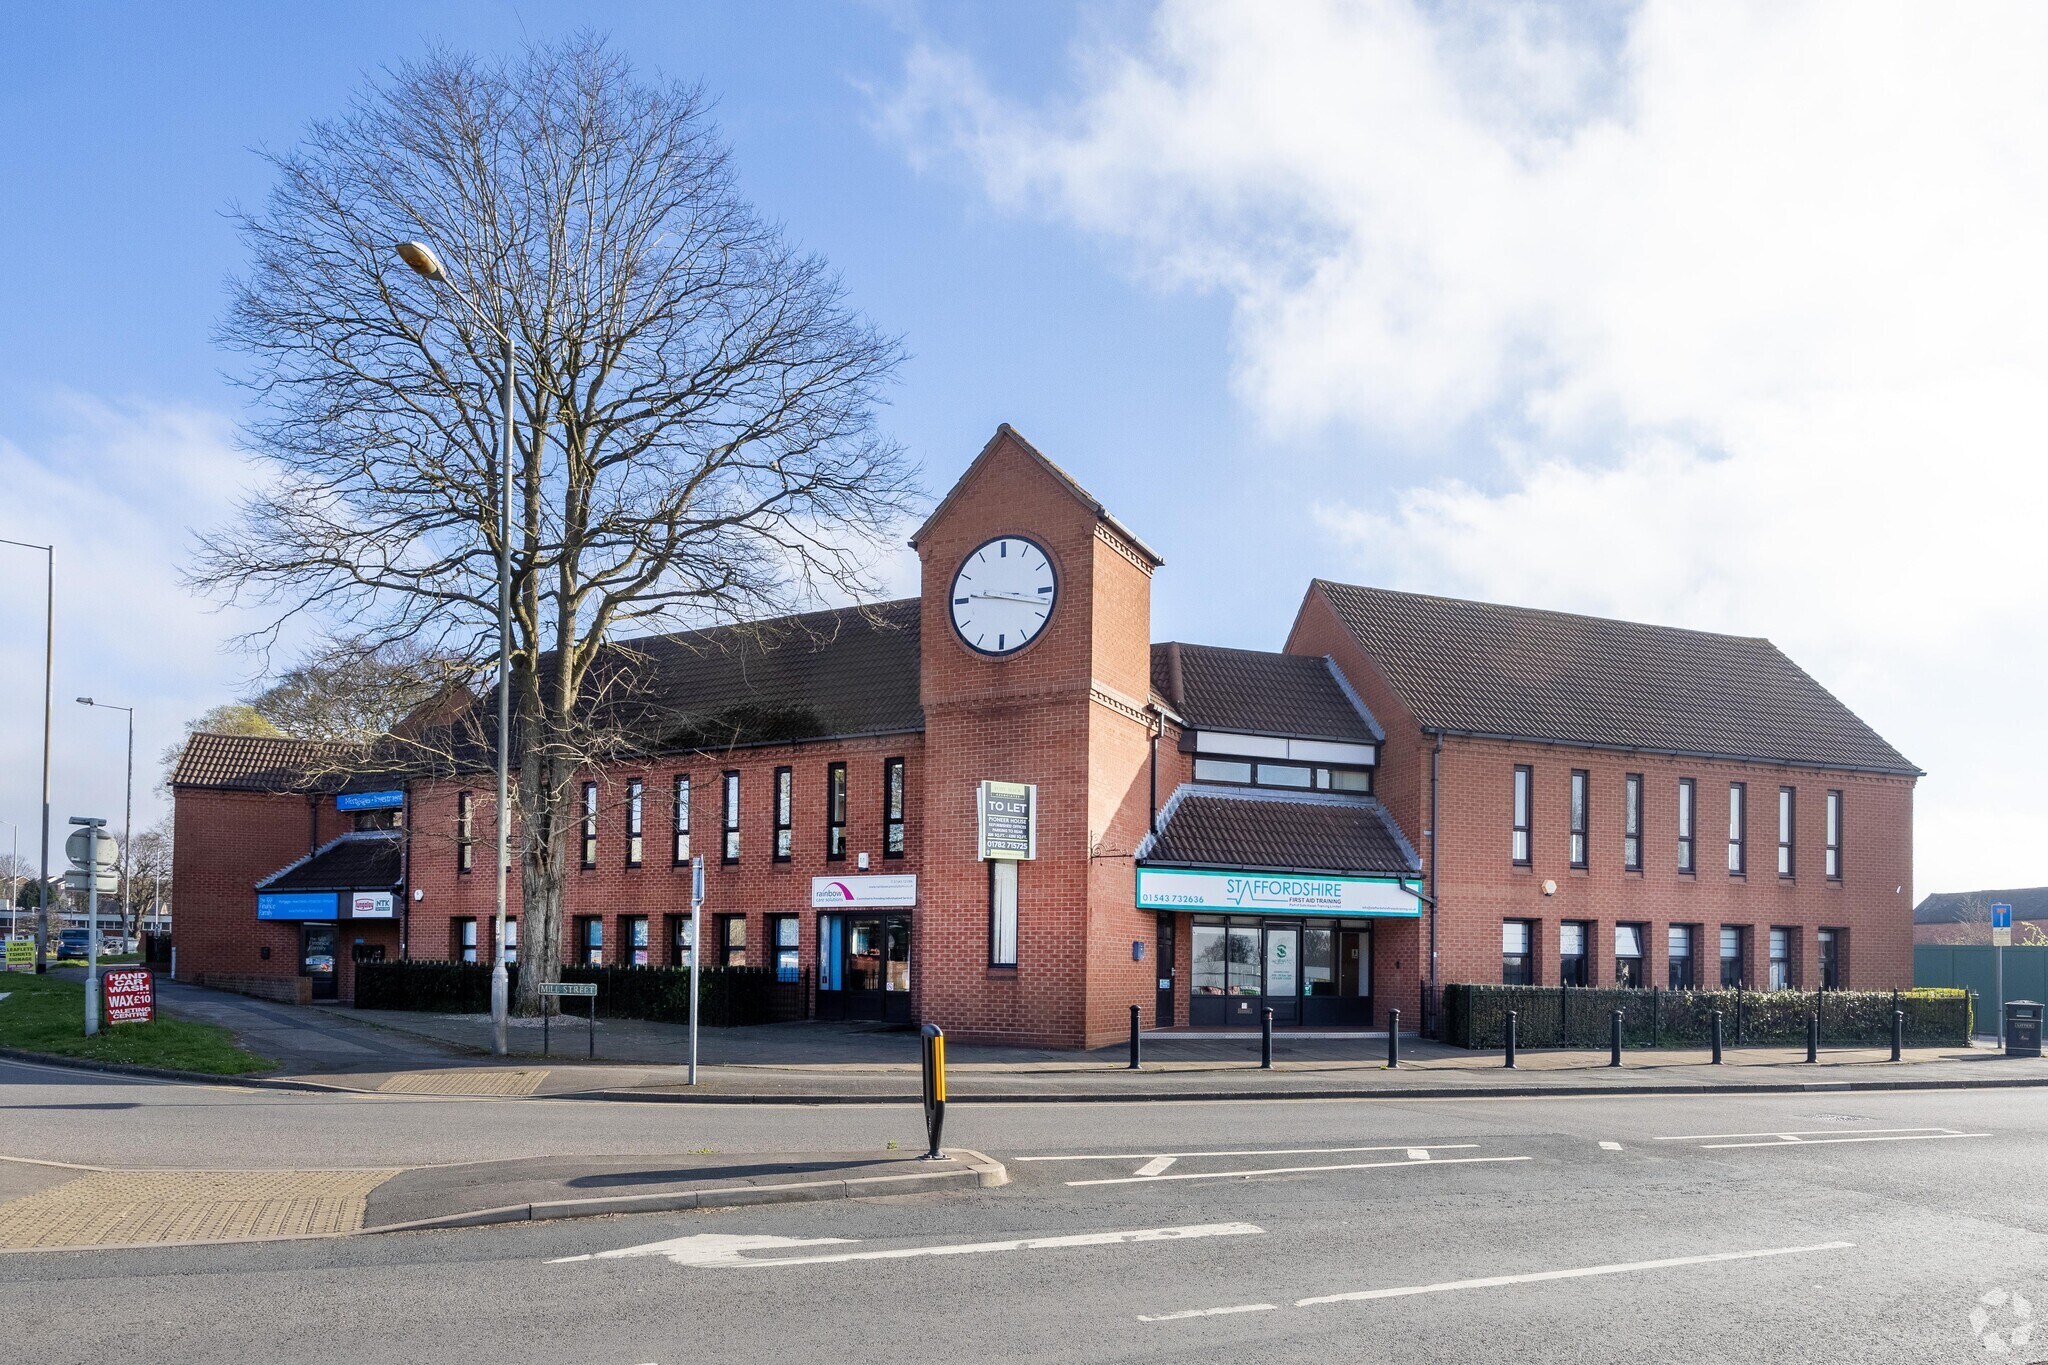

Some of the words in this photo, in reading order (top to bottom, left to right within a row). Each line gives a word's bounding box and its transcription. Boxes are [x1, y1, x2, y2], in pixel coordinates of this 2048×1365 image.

[988, 801, 1005, 811] TO
[1007, 802, 1027, 813] LET
[1227, 879, 1342, 897] STAFFORDSHIRE
[816, 889, 843, 897] rainbow
[376, 899, 390, 907] NTK
[1142, 894, 1170, 903] 01543
[1171, 895, 1204, 904] 732636
[109, 972, 148, 981] HAND
[108, 984, 150, 993] WASH
[540, 985, 560, 993] MILL
[563, 985, 595, 994] STREET
[108, 995, 134, 1008] WAX
[133, 995, 151, 1004] £10
[108, 1007, 151, 1015] VALETING
